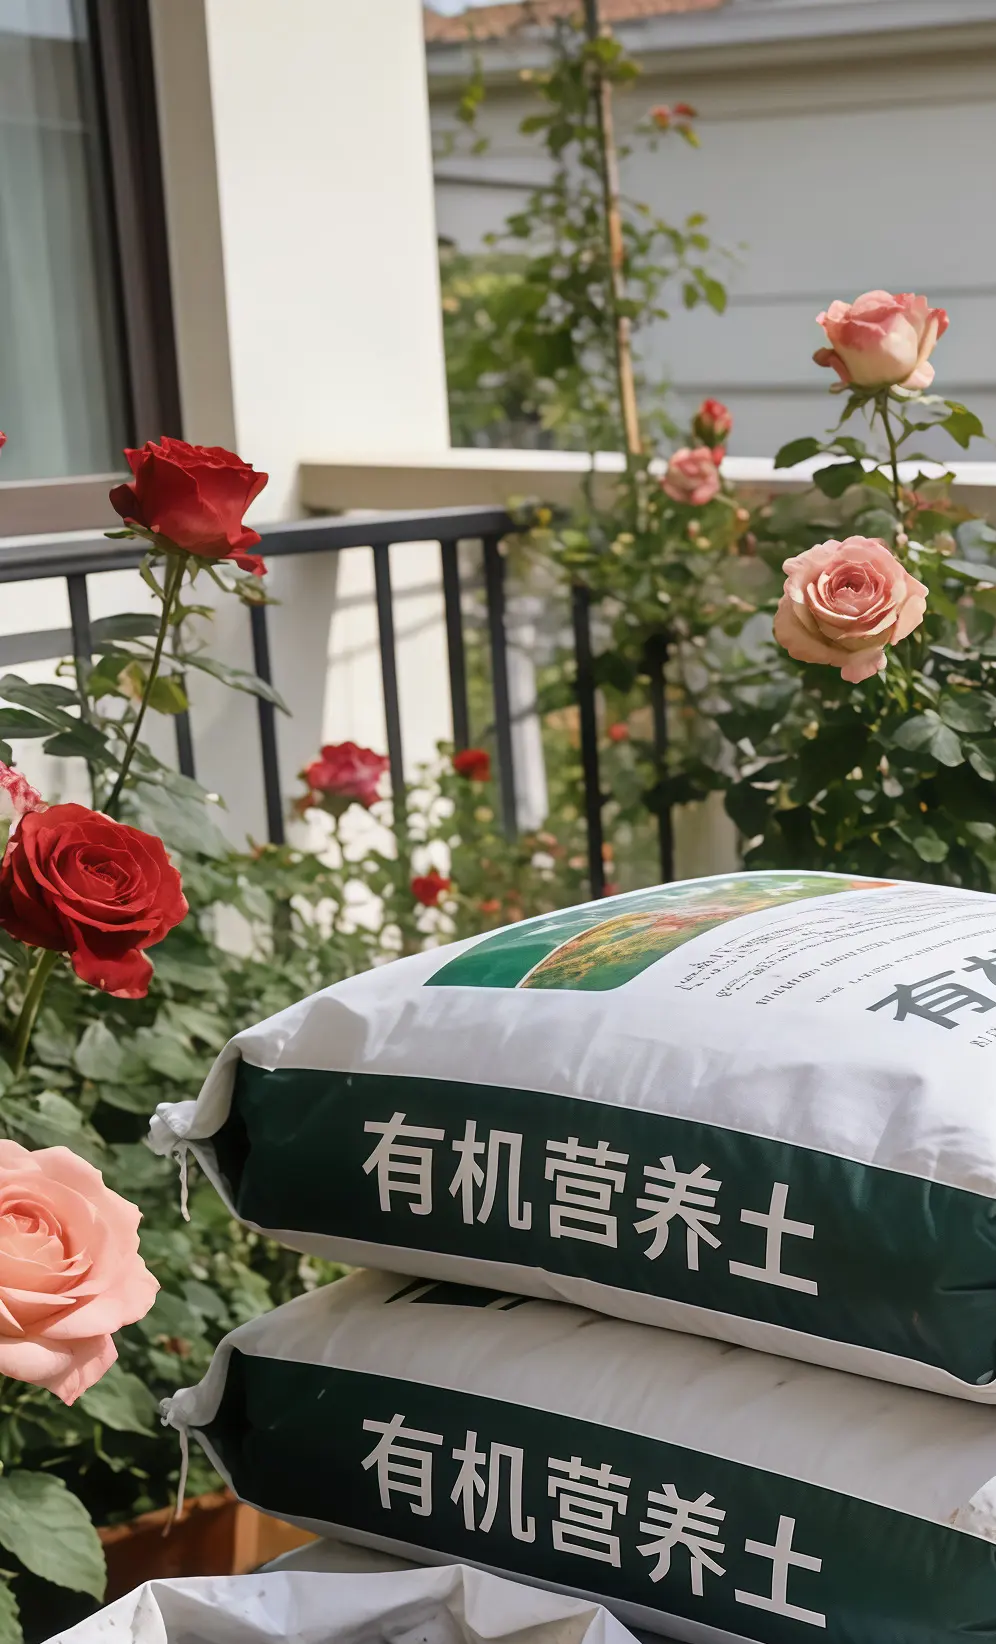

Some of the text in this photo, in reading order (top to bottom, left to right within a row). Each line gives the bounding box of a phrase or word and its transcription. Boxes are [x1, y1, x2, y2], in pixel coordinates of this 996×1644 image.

[362, 1112, 818, 1296] 有机营养土
[361, 1414, 826, 1629] 有机营养土
